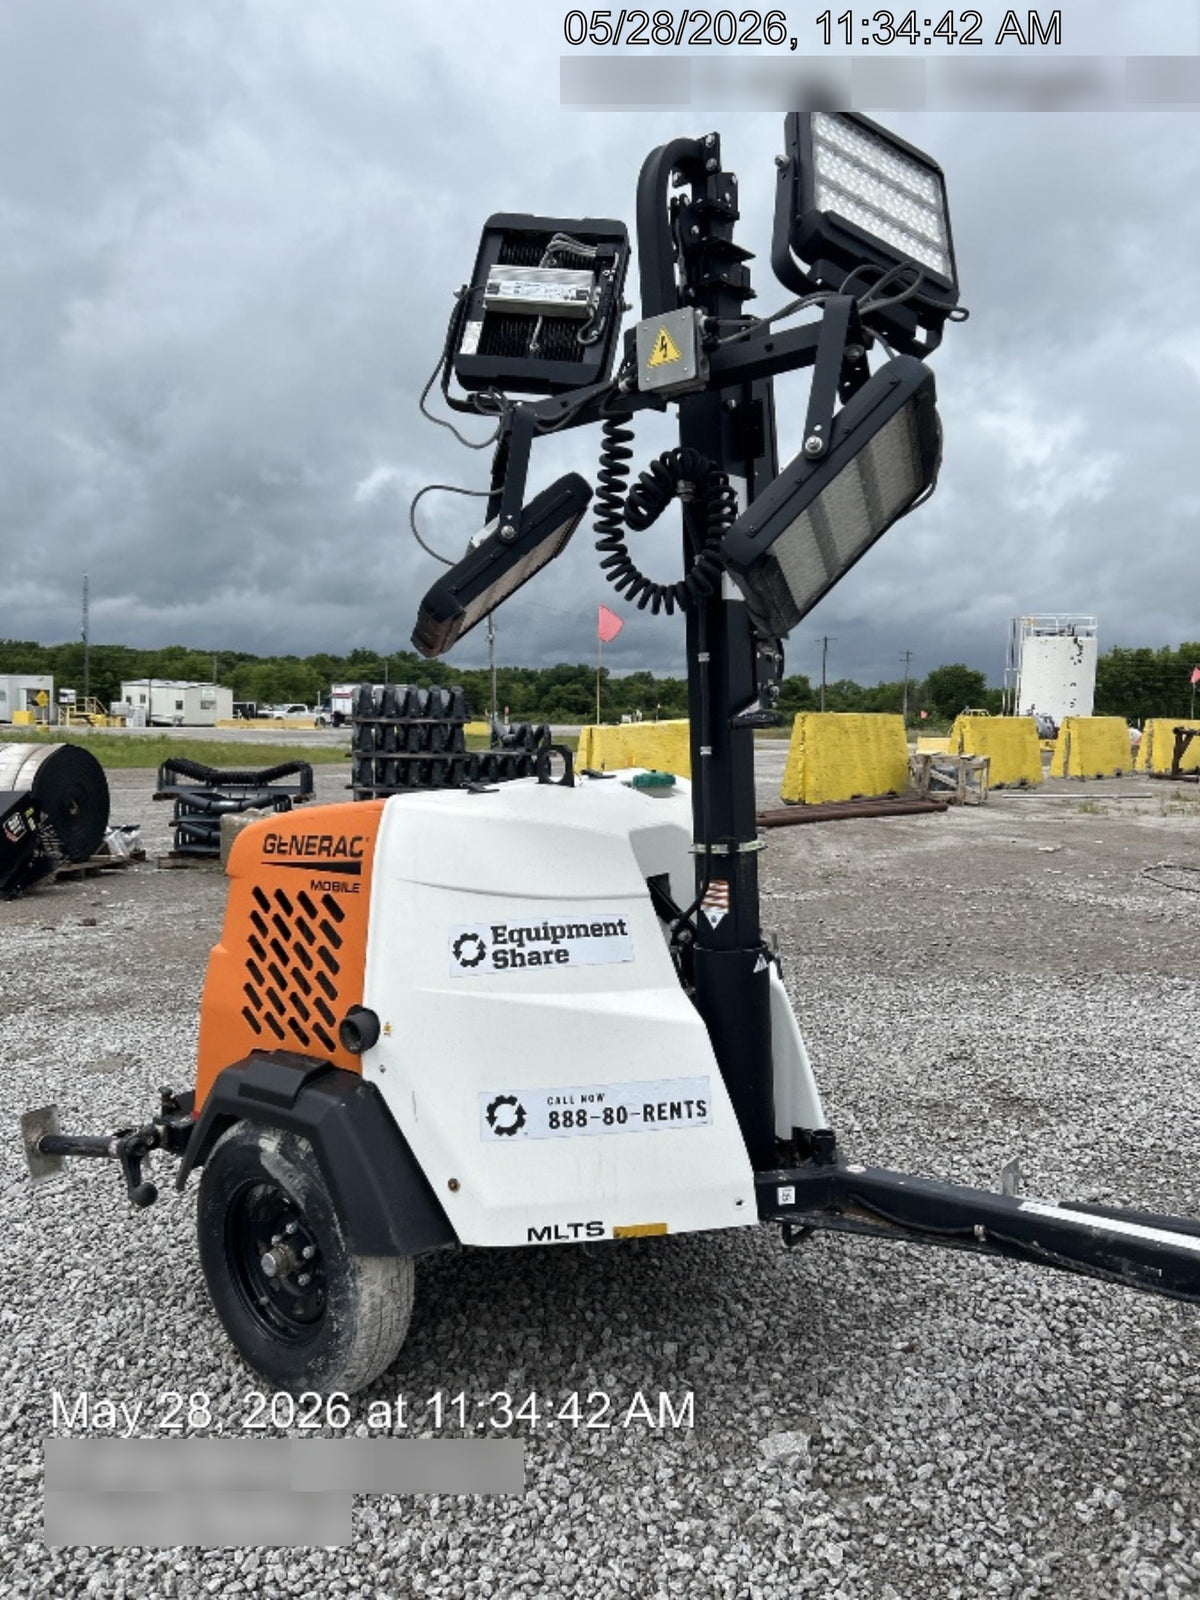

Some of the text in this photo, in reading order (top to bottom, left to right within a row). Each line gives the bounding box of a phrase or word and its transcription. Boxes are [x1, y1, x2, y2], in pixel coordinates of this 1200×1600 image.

[262, 833, 364, 858] GENERAC
[311, 880, 361, 893] MOBILE
[490, 919, 629, 948] Equipment
[492, 948, 570, 970] Share
[547, 1092, 606, 1105] CALL NOW
[548, 1100, 707, 1130] 888-80-RENTS
[527, 1221, 606, 1242] MLTS
